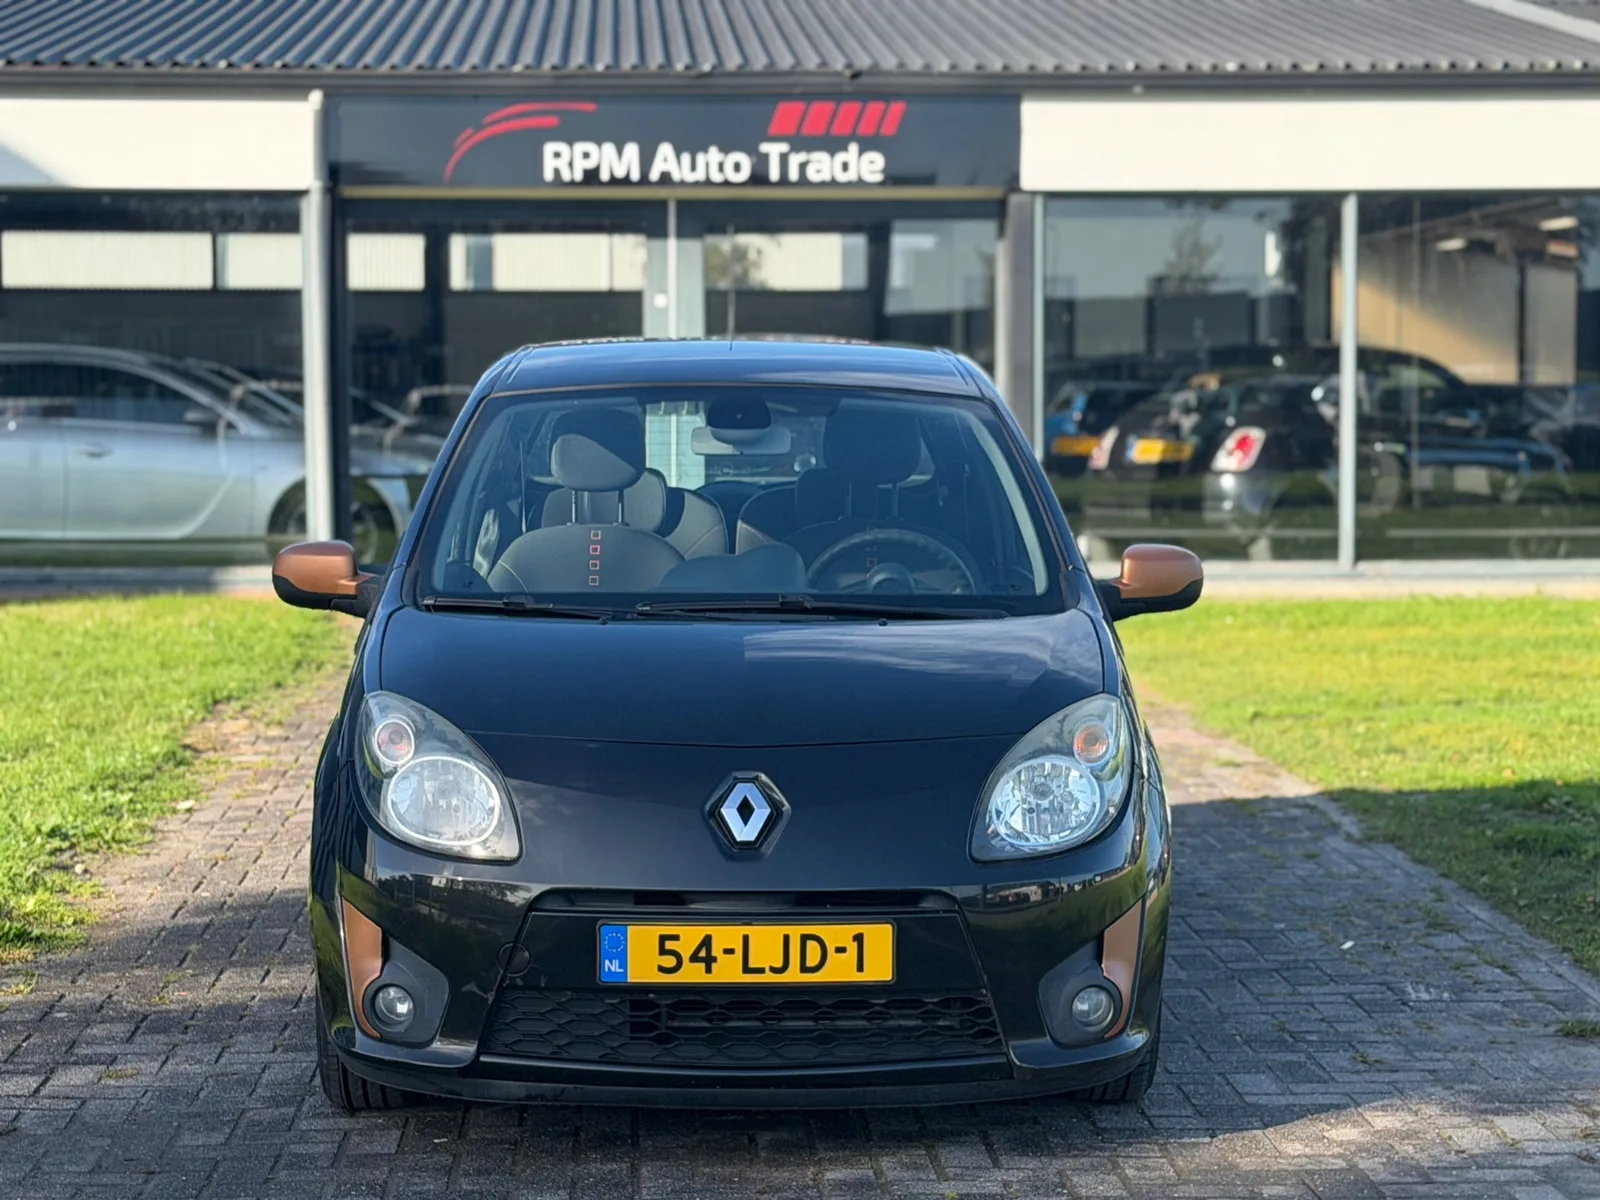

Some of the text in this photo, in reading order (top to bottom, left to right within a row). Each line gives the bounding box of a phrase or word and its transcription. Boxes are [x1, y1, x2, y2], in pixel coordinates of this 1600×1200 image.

[542, 140, 886, 184] RPM Auto Trade
[603, 959, 624, 973] NL
[656, 932, 865, 975] 54-LJD-1
